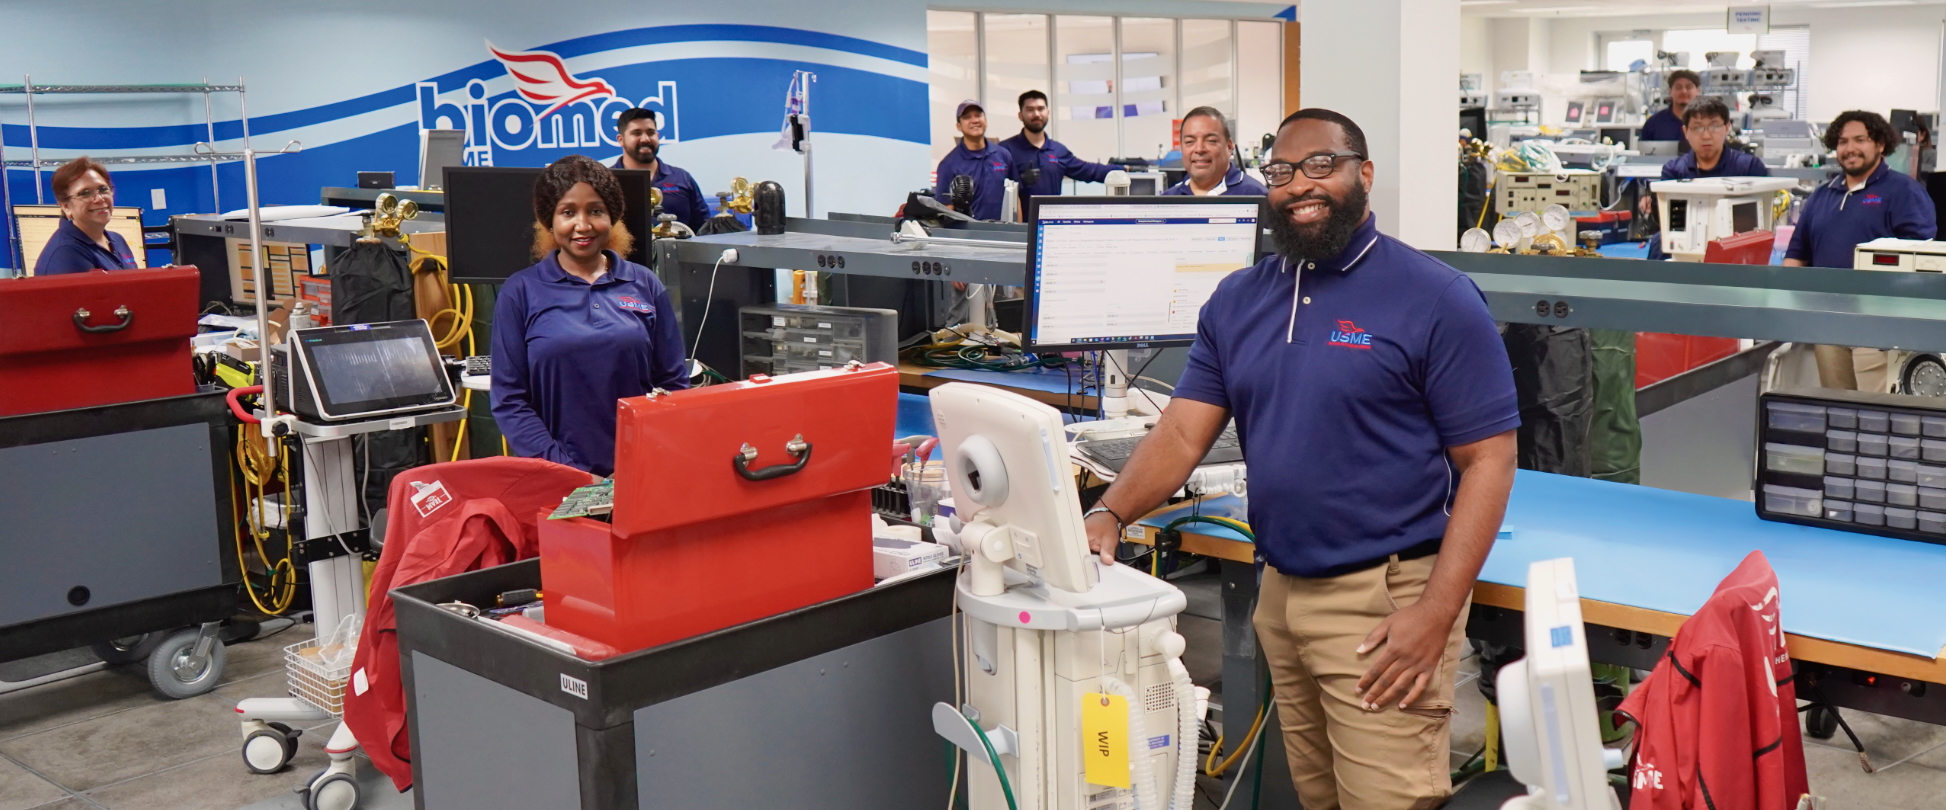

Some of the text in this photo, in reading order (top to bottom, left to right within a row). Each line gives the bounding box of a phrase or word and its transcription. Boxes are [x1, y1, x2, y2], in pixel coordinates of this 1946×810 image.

[416, 78, 679, 151] biomed
[1330, 330, 1372, 345] USME
[562, 676, 586, 696] ULINE
[1098, 731, 1109, 757] WIP
